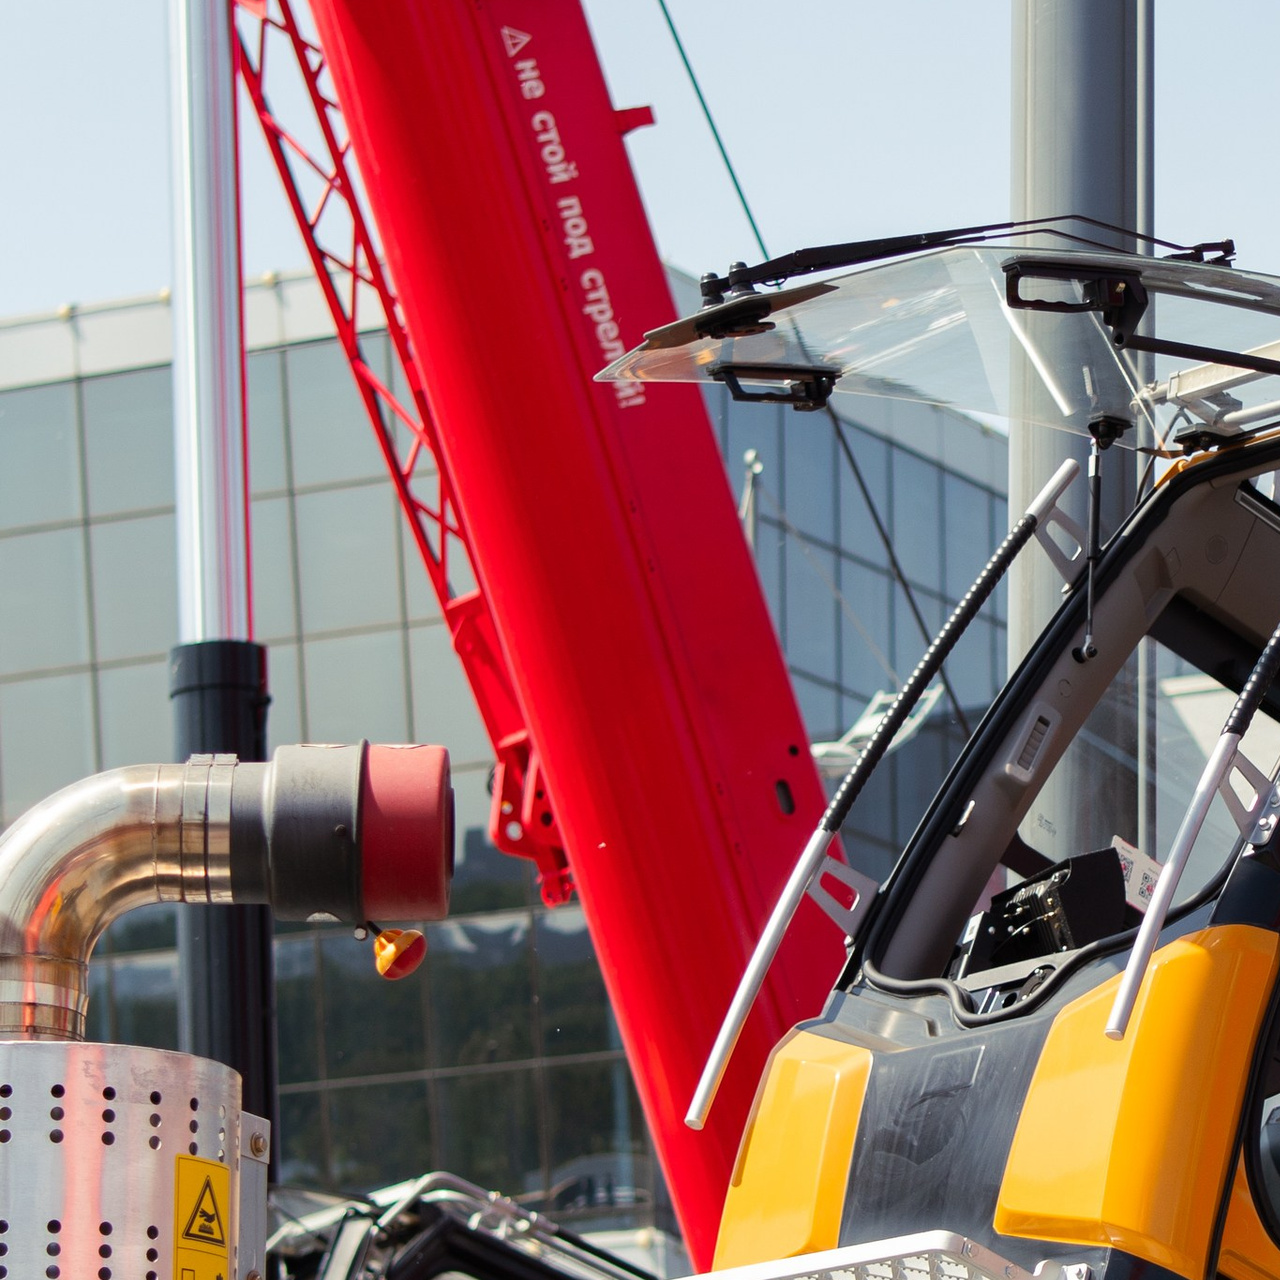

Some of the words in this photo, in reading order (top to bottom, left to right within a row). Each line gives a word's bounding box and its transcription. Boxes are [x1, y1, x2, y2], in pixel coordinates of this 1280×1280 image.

[514, 58, 546, 100] не
[531, 110, 579, 184] стой
[557, 195, 595, 260] под
[580, 268, 647, 409] стрелй!
